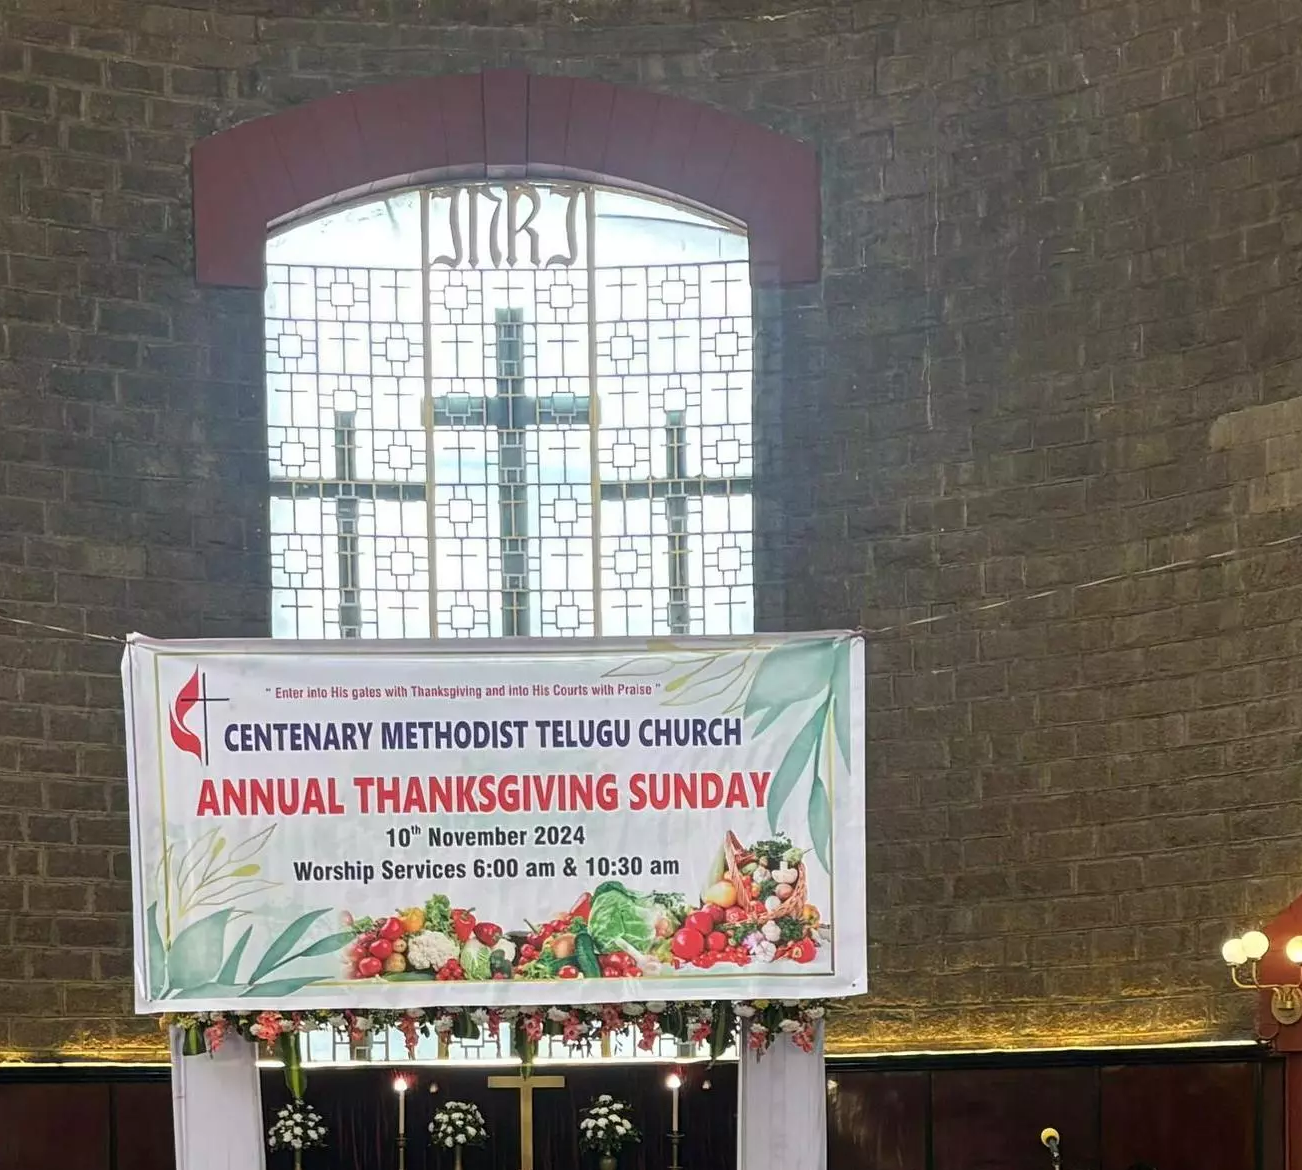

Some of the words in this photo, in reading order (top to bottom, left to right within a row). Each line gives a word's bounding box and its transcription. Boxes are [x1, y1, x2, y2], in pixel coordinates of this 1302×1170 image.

[275, 687, 303, 699] Enter
[307, 687, 328, 699] into
[331, 686, 349, 698] His
[352, 686, 381, 700] gates
[385, 685, 408, 698] with
[411, 685, 482, 699] Thanksgiving
[485, 684, 505, 697] and
[509, 684, 529, 697] into
[532, 684, 550, 697] His
[553, 684, 588, 697] Courts
[591, 683, 614, 696] with
[618, 683, 652, 696] Praise
[224, 722, 373, 752] CENTENARY
[381, 720, 528, 750] METHODIST
[535, 718, 631, 748] TELUGU
[638, 718, 742, 747] CHURCH
[196, 777, 345, 817] ANNUAL
[353, 773, 619, 814] THANKSGIVING
[629, 771, 772, 811] SUNDAY
[386, 824, 421, 848] 10th
[428, 826, 527, 847] November
[534, 825, 586, 845] 2024
[293, 860, 375, 885] Worship
[381, 859, 467, 880] Services
[473, 858, 519, 878] 6:00
[525, 861, 556, 877] am
[562, 857, 578, 877] &
[585, 856, 643, 877] 10:30
[650, 859, 680, 875] am
